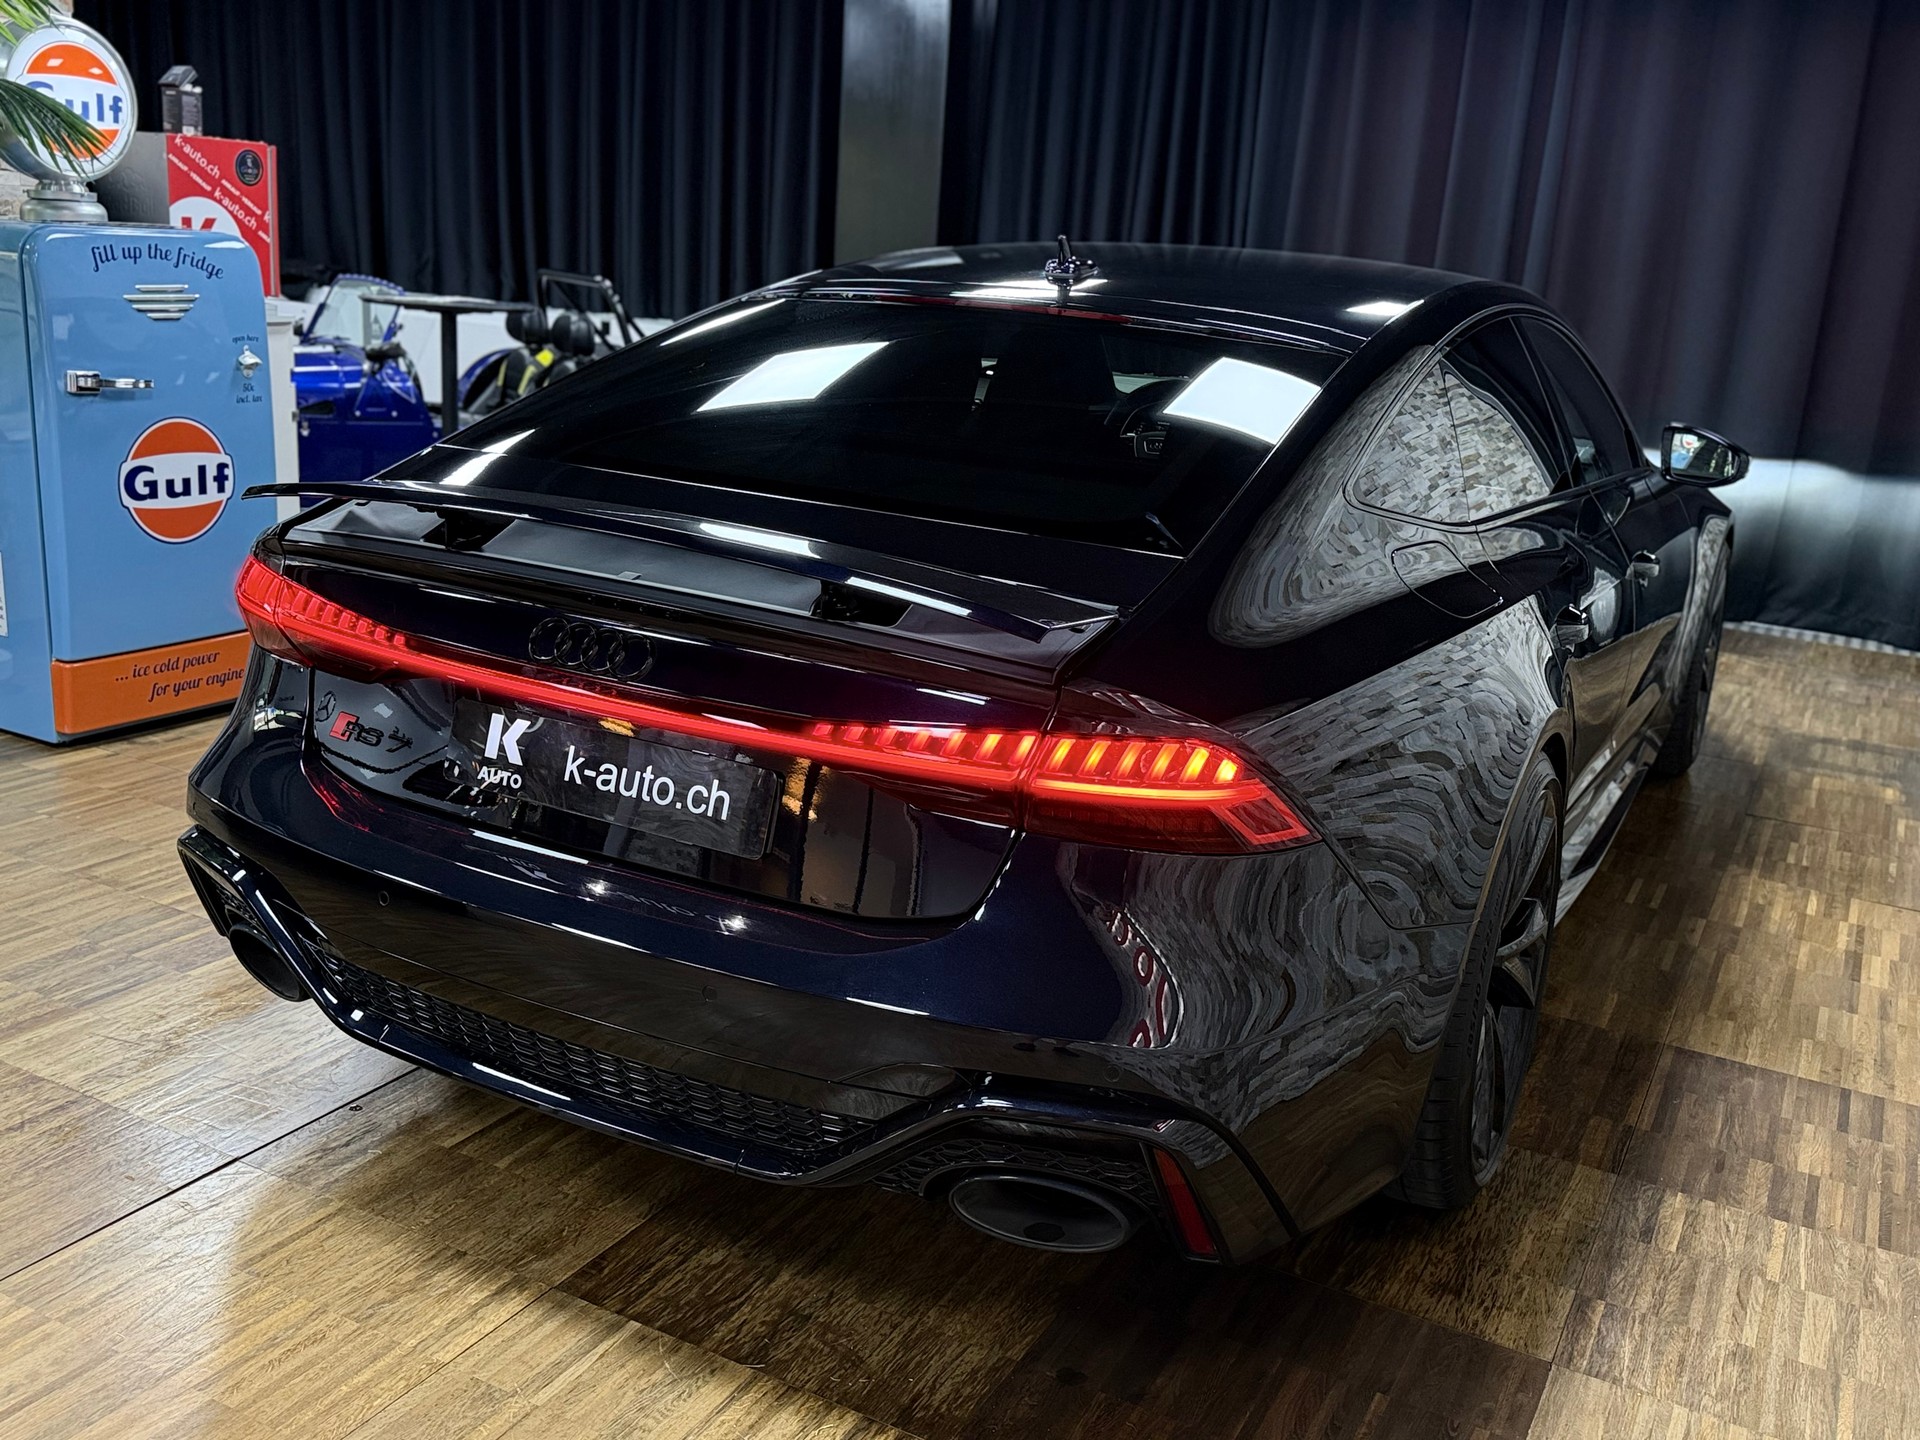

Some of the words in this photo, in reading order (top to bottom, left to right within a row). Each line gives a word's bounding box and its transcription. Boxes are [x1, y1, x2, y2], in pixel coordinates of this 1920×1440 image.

[174, 133, 220, 179] k-auto.ch
[213, 187, 257, 230] k-auto.ch
[91, 244, 118, 273] fill
[121, 246, 142, 265] up
[147, 243, 173, 261] the
[173, 246, 224, 280] fridge
[123, 462, 230, 502] Gulf
[132, 664, 150, 679] ice
[153, 657, 180, 674] cold
[182, 652, 221, 673] power
[148, 682, 170, 703] for
[173, 677, 204, 697] your
[206, 668, 245, 687] engine
[484, 712, 532, 766] K
[477, 765, 522, 789] AUTO
[564, 745, 730, 821] k-auto.ch
